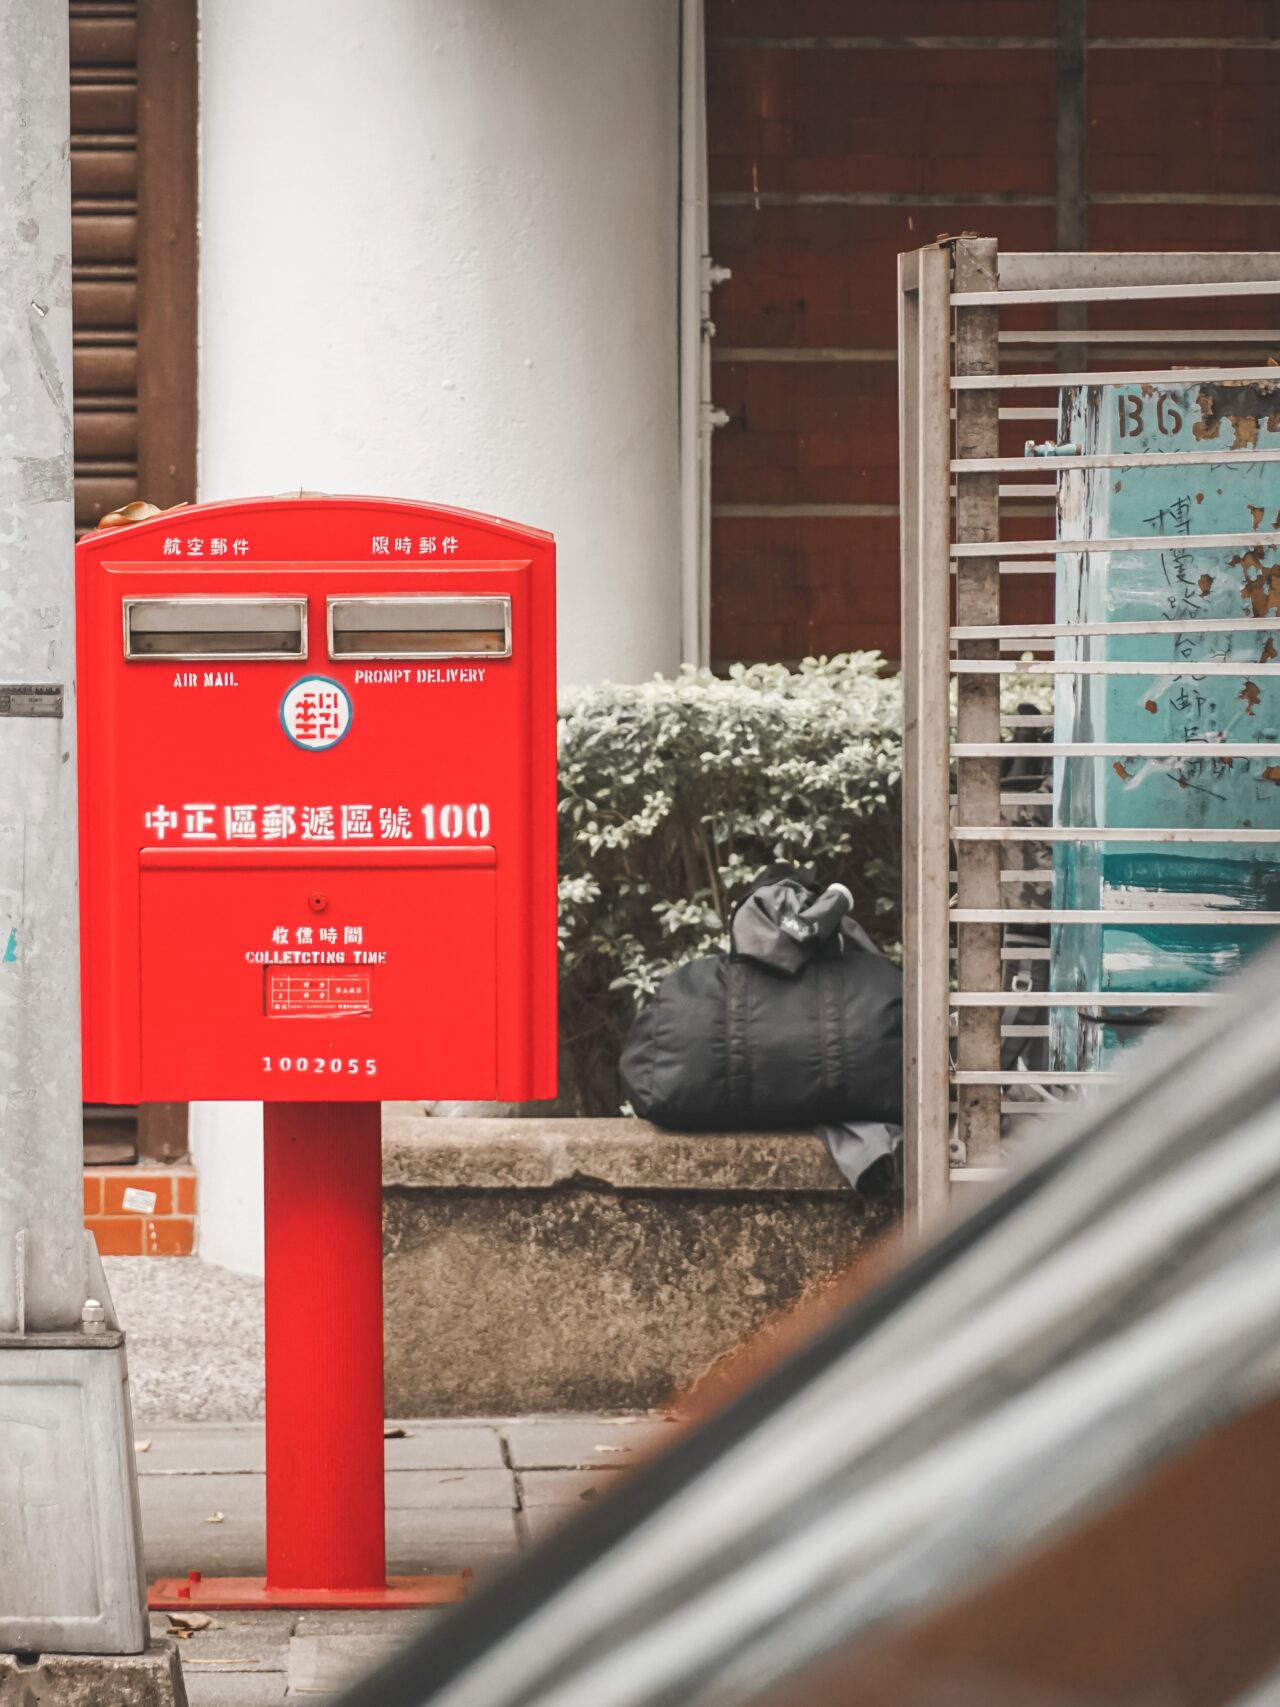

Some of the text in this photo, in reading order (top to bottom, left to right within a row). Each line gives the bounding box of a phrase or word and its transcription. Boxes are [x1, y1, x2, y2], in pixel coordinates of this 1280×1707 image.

[163, 537, 250, 556] 航空郵件
[372, 535, 459, 555] 限時郵件
[173, 671, 239, 688] AIR MAIL
[354, 668, 486, 684] PROMPT DELIVERY
[145, 803, 490, 841] 中正區郵遞區號 100
[271, 926, 363, 945] 收信時間
[245, 950, 387, 964] COLLETCTING TIME
[262, 1056, 377, 1076] 1002055
